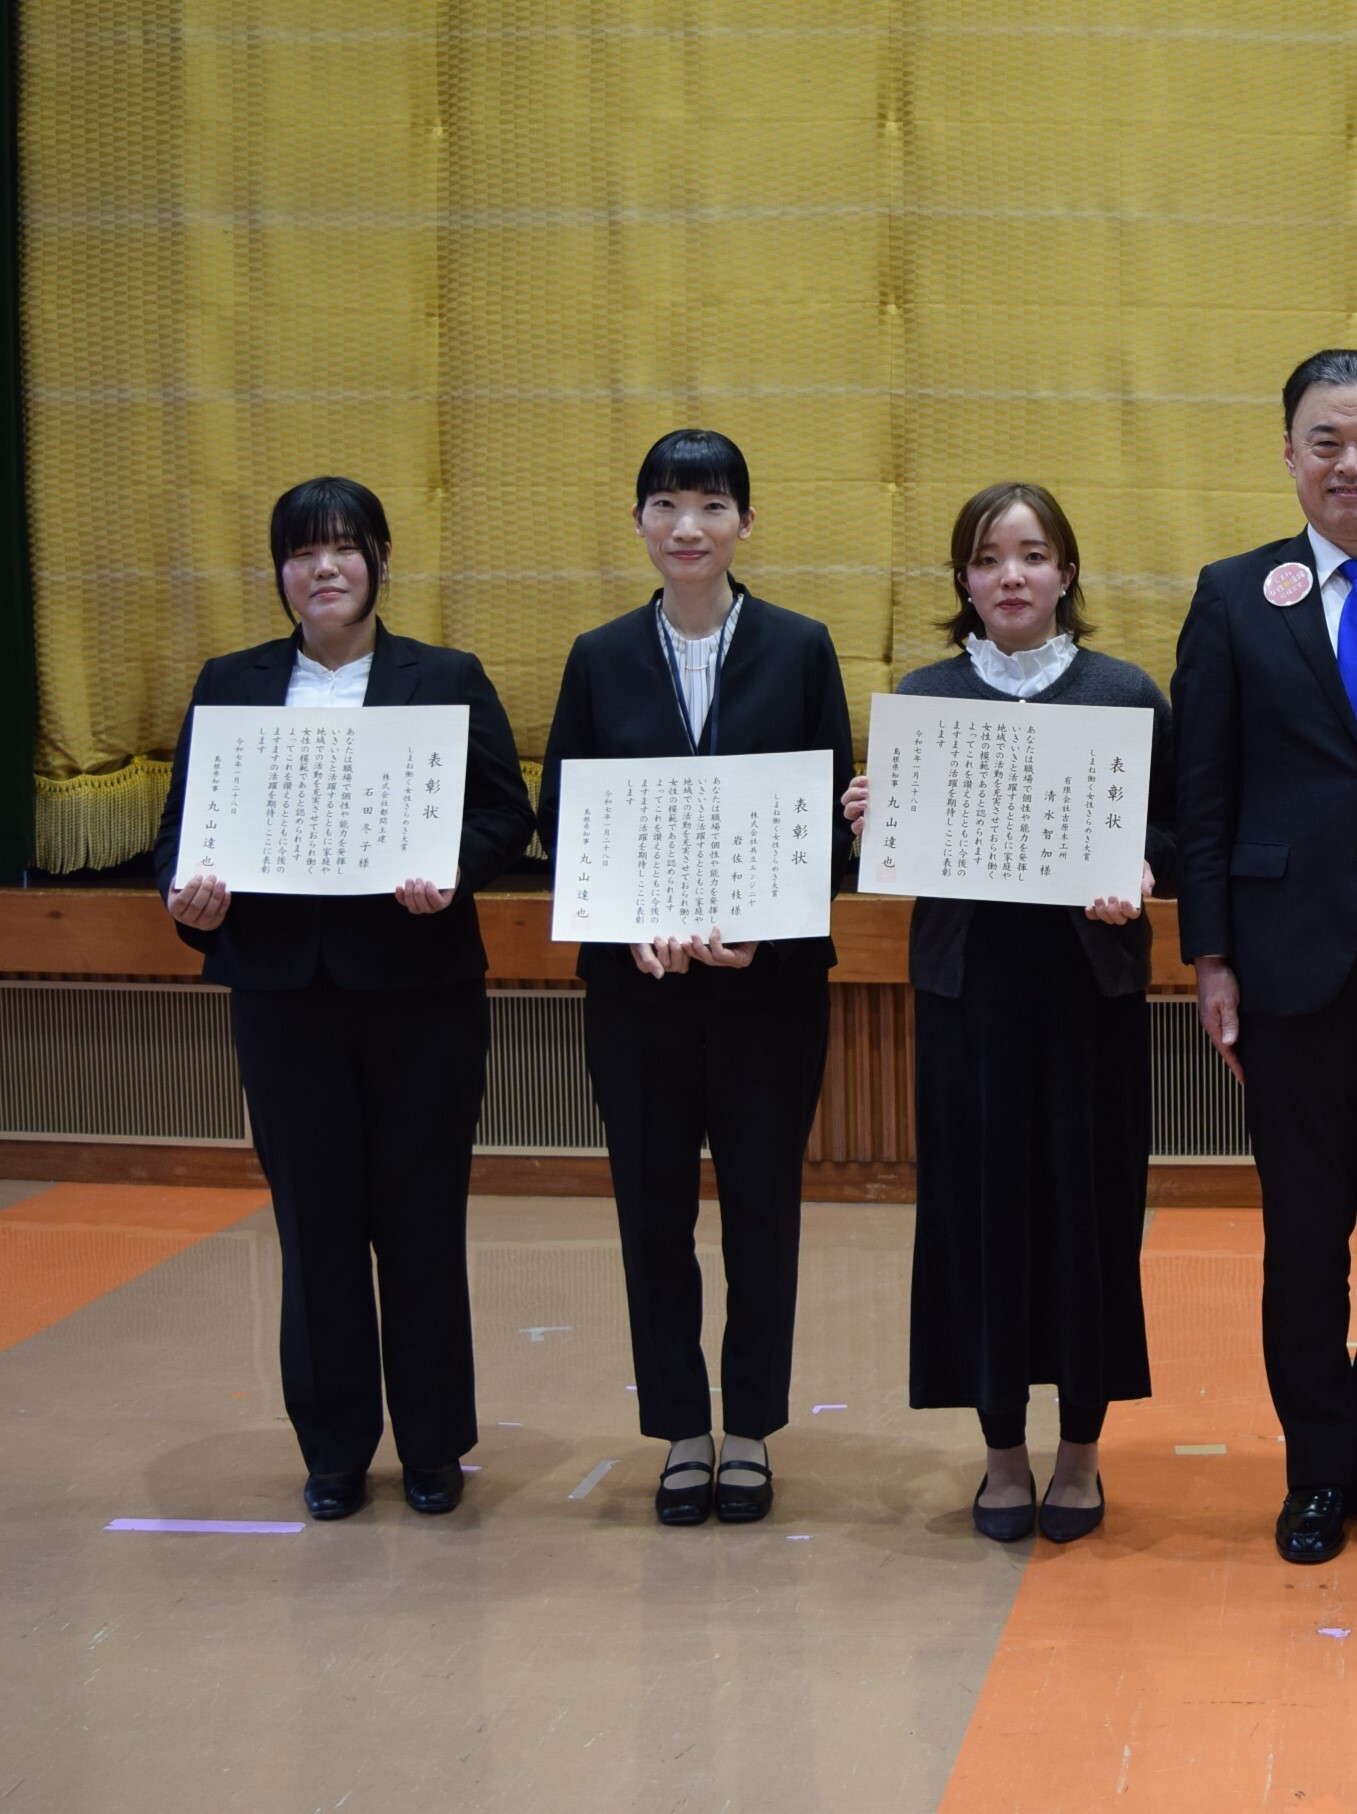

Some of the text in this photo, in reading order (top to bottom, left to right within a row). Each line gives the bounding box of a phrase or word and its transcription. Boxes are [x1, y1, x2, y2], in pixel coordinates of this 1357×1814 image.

[230, 738, 244, 814] 令和七年一月二十八日
[256, 728, 267, 753] します
[421, 752, 443, 819] 表彰状
[910, 730, 924, 812] 令和七年一月二十八日
[935, 720, 946, 748] します
[200, 800, 220, 866] 丸山達也
[260, 728, 282, 873] ますますの活躍を期待しここに表彰
[292, 728, 312, 861] 女性の模範であると認められます
[305, 728, 327, 874] 地域での活動を充実させておられ働く
[321, 729, 341, 873] いきいきと活躍するとともに家庭や
[335, 728, 355, 874] あなたは職場で個性や能力を発揮し
[400, 747, 414, 850] しまね働く女性きらめき大賞
[602, 791, 613, 866] 令和七年一月二十八日
[625, 780, 635, 805] します
[665, 778, 679, 911] 女性の模範であると認められます
[771, 794, 781, 897] しまね働く女性きらめき大賞
[791, 798, 809, 865] 表彰状
[882, 796, 901, 868] 丸山達也
[941, 721, 962, 878] ますますの活躍を期待しここに表彰
[972, 723, 993, 865] 女性の模範であると認められます
[986, 723, 1008, 879] 地域での活動を充実させておられ働く
[1001, 726, 1022, 880] いきいきと活躍するとともに家庭や
[1016, 725, 1036, 881] あなたは職場で個性や能力を発揮し
[1039, 790, 1057, 876] 清水智加様
[1082, 749, 1097, 861] しまね働く女性きらめき大賞
[1104, 756, 1126, 829] 表彰状
[576, 853, 592, 919] 丸山達也
[635, 779, 650, 924] ますますの活躍を期待しここに表彰
[679, 777, 694, 924] 地域での活動を充実させておられ働く
[693, 779, 707, 923] いきいきと活躍するとともに家庭や
[708, 777, 722, 924] あなたは職場で個性や能力を発揮し
